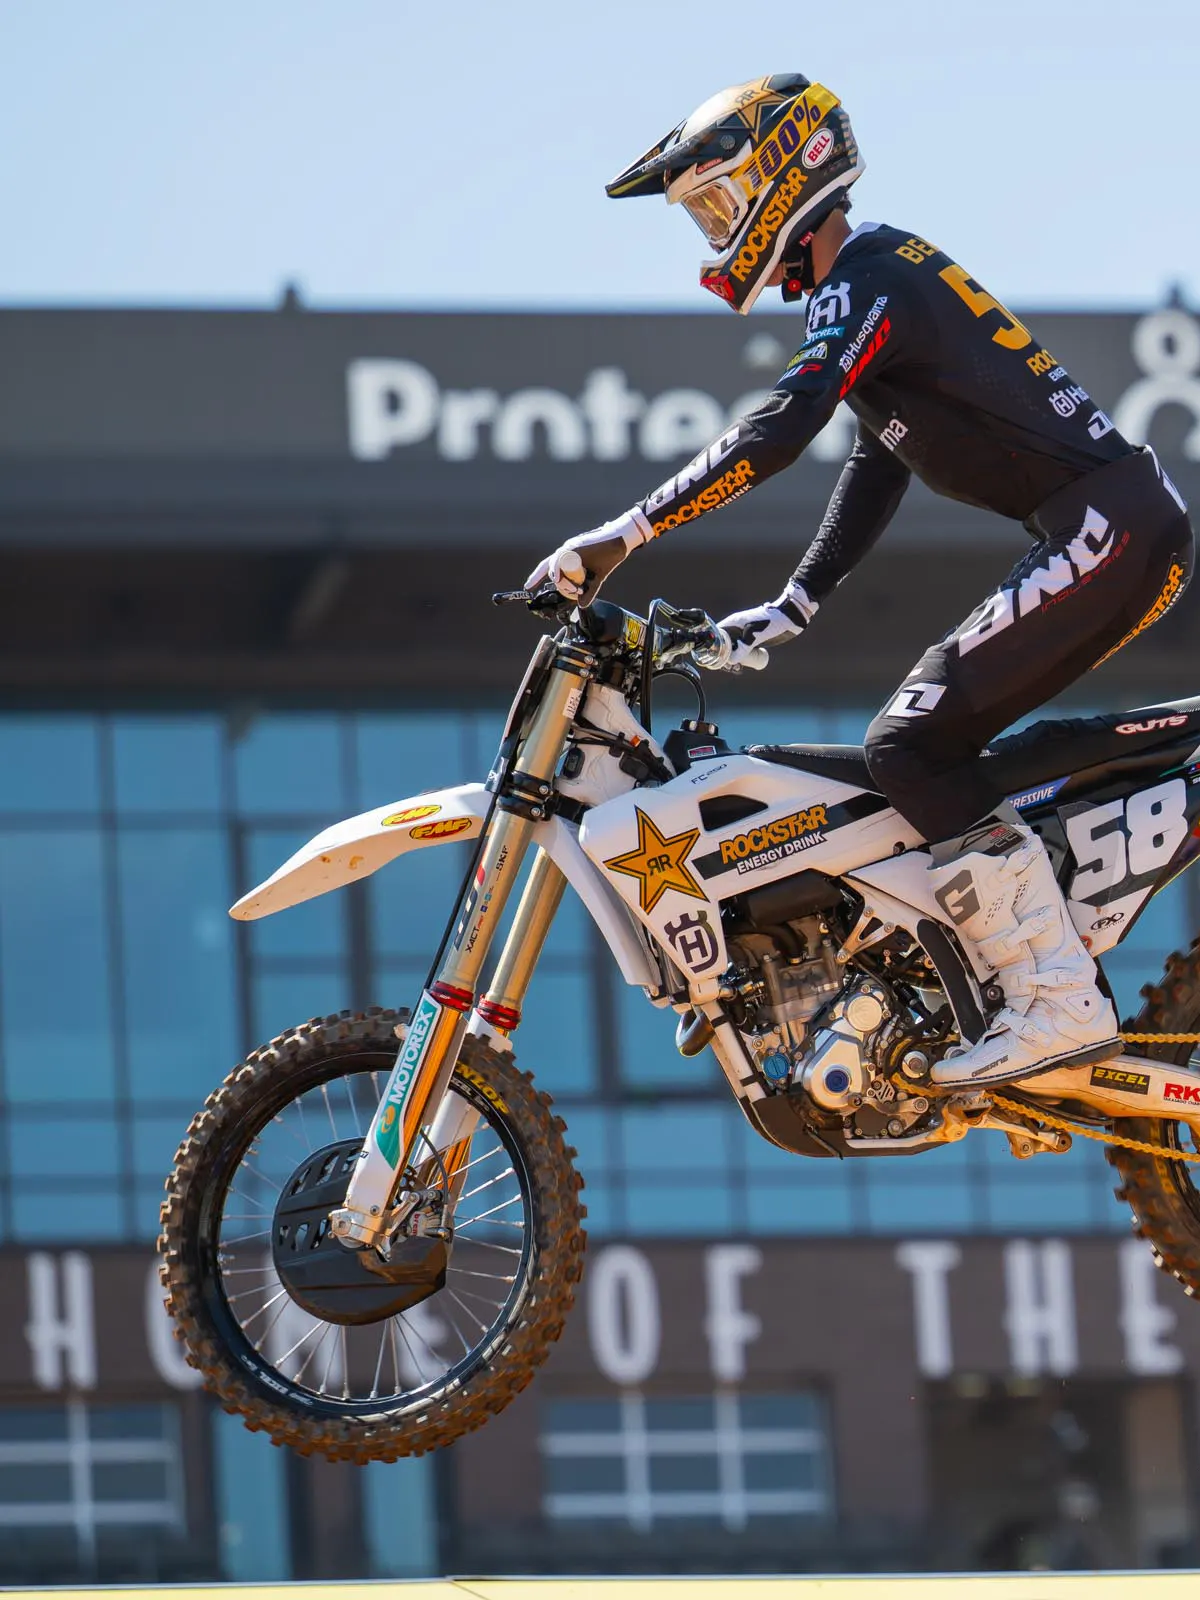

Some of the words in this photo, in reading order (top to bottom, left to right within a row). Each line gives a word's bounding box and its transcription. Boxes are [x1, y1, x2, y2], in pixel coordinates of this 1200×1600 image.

[742, 95, 822, 191] 100%
[807, 135, 831, 163] BELL
[730, 166, 809, 283] ROCKSTAR
[846, 295, 888, 360] Husqvarna
[1114, 714, 1188, 735] GUTS
[719, 804, 829, 865] ROCKSTAR
[737, 848, 784, 876] ENERGY
[783, 831, 826, 858] DRINK
[1065, 778, 1189, 900] 58
[389, 1006, 434, 1106] MOTOREX
[1092, 1068, 1148, 1086] EXCEL
[588, 1243, 764, 1387] OF
[893, 1238, 1186, 1378] THE
